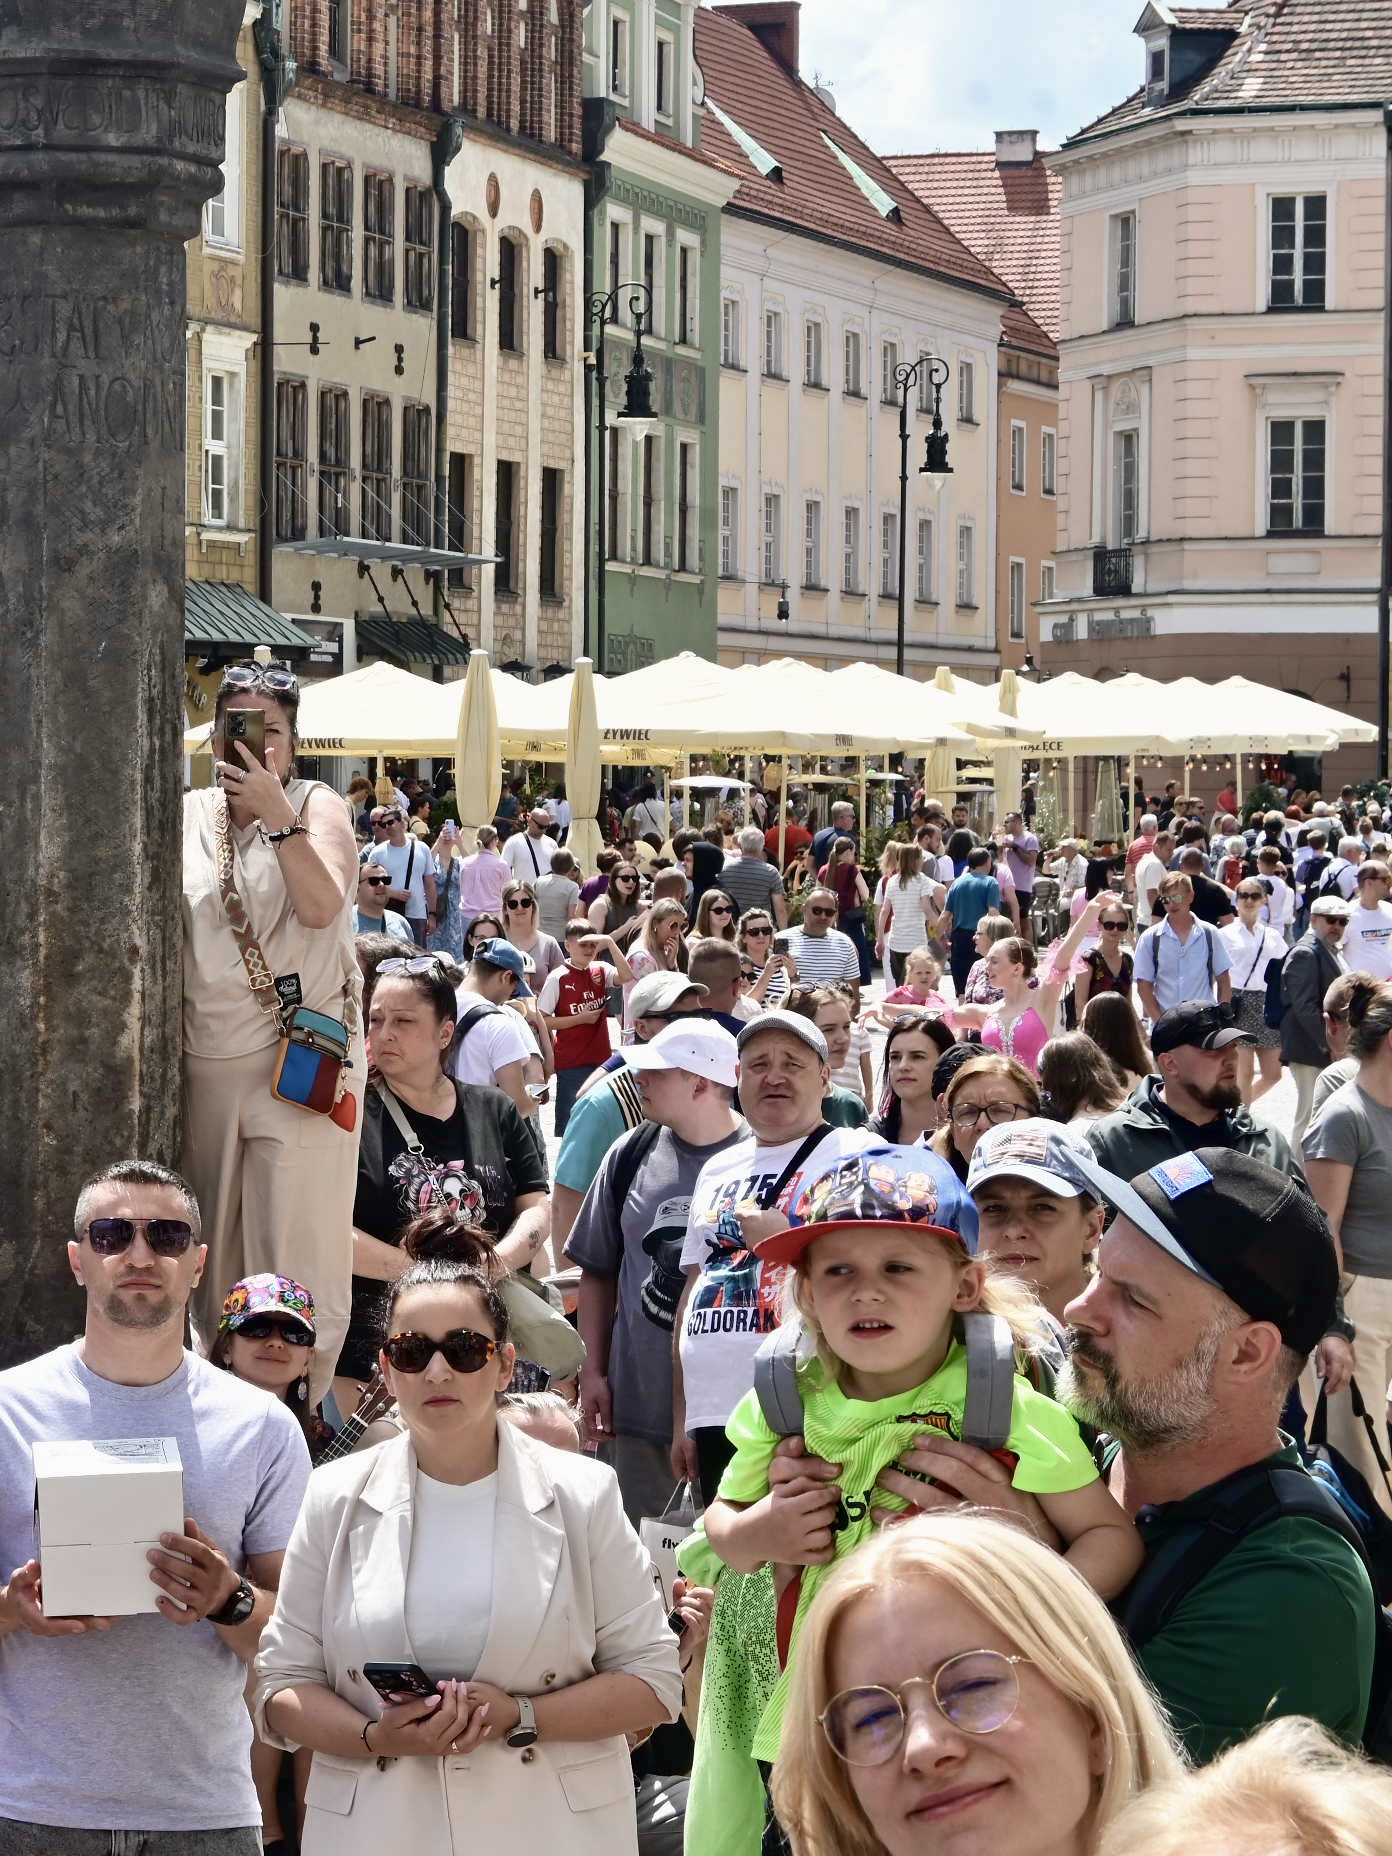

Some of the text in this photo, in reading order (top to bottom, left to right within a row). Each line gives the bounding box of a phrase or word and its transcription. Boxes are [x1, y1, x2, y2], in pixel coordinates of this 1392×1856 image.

[569, 996, 606, 1015] Emirate
[709, 1173, 778, 1211] 1975
[688, 1308, 776, 1337] GOLDORAK
